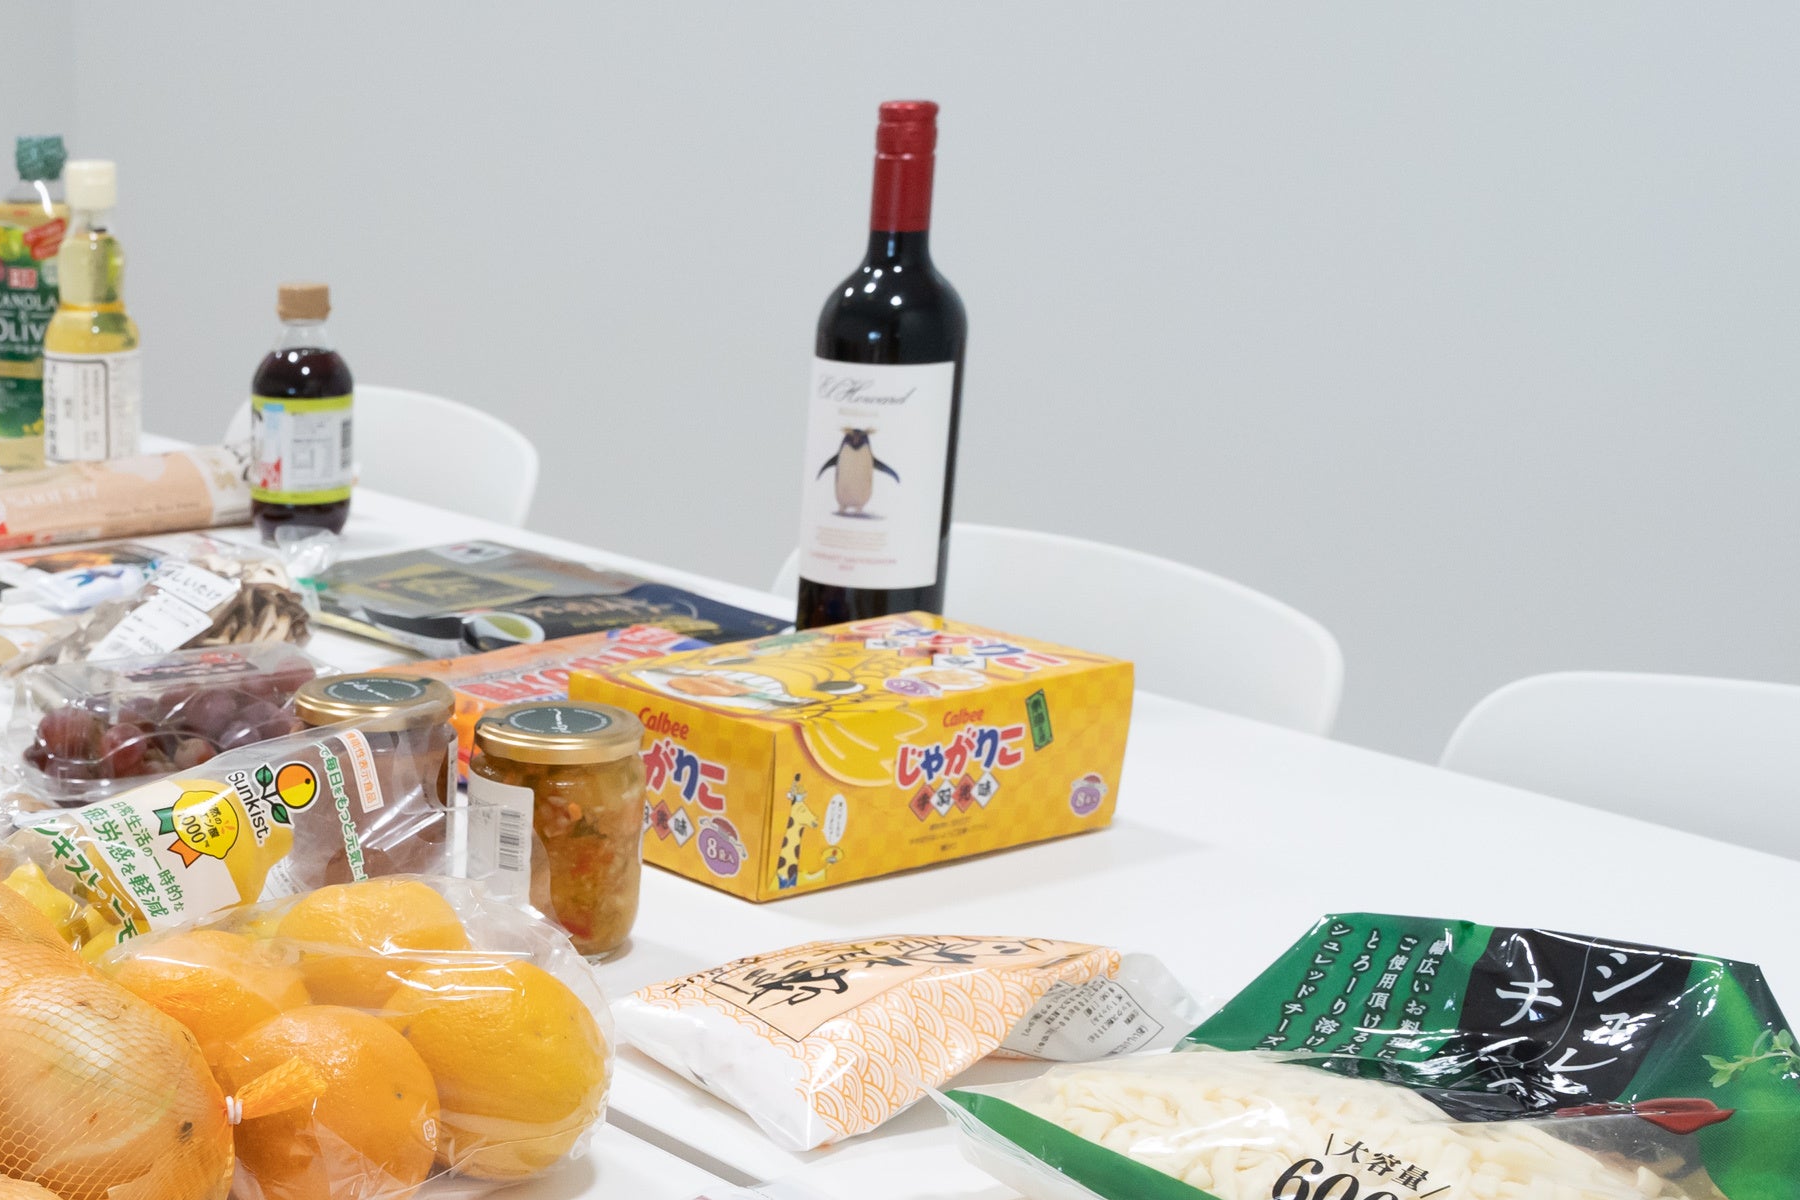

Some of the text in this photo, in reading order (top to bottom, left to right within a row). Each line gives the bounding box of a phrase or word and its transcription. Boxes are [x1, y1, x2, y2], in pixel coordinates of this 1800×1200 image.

[638, 706, 690, 740] Calbee
[943, 708, 984, 728] Calbee
[898, 726, 1024, 787] じゃがりこ
[228, 771, 270, 840] Sunkist
[81, 807, 170, 918] 疲労感を軽減
[111, 801, 185, 913] 日常生活の一時的な
[1332, 1140, 1433, 1193] 大容量
